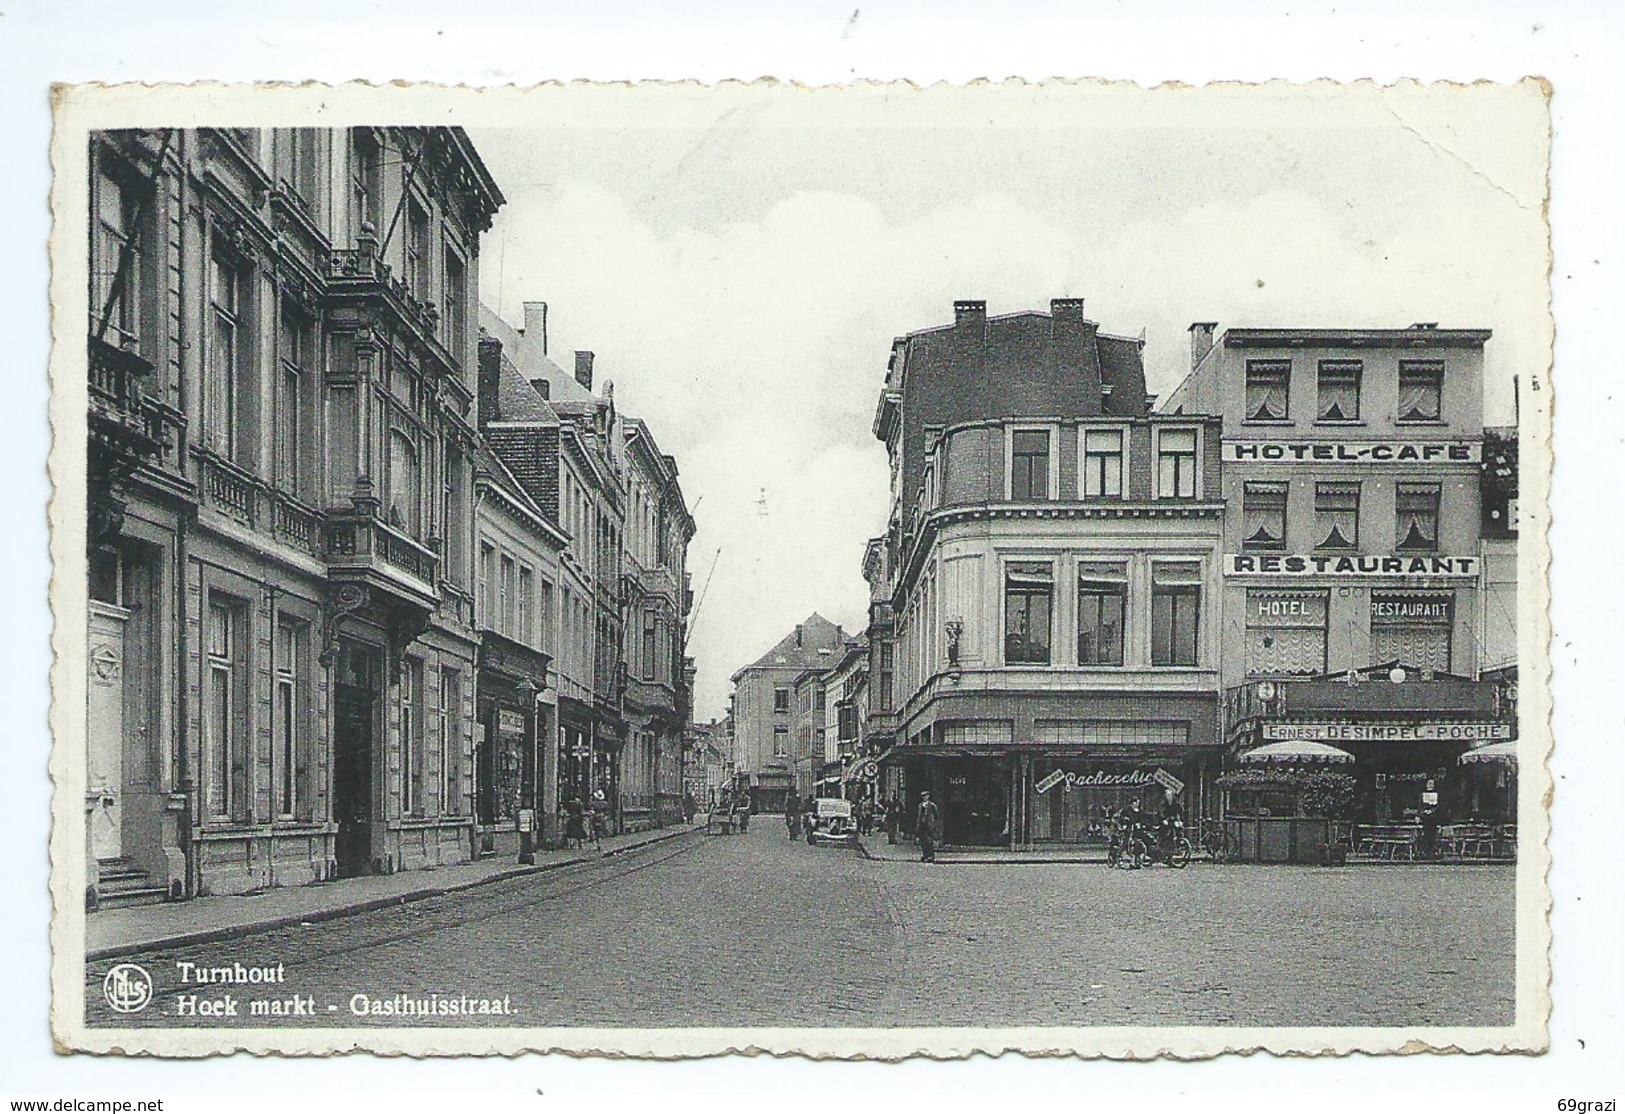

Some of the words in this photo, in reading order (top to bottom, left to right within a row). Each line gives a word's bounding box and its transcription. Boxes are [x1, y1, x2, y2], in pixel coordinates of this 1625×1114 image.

[1234, 556, 1474, 573] RESTAURANT
[1258, 601, 1310, 616] HOTEL
[1371, 602, 1449, 617] RESTAURANT
[1269, 725, 1321, 738] ERNEST
[1327, 725, 1504, 739] DESIMPEL-POCHE
